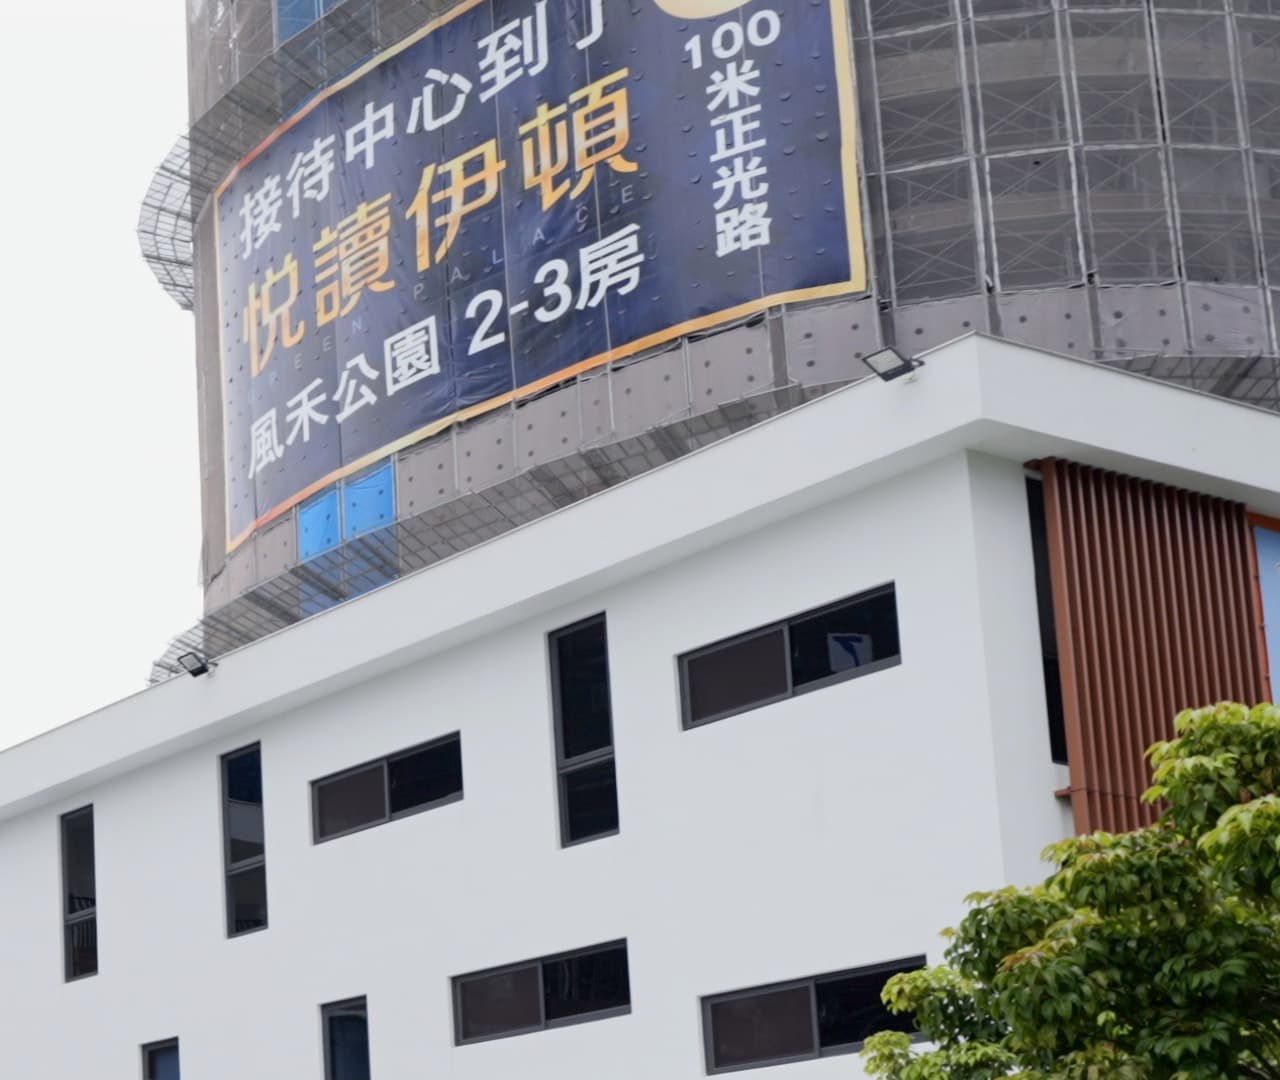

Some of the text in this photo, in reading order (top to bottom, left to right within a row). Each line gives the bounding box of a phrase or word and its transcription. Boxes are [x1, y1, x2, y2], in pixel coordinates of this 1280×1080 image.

[413, 184, 635, 300] PALACE
[248, 223, 645, 480] 風禾公園 2-3房
